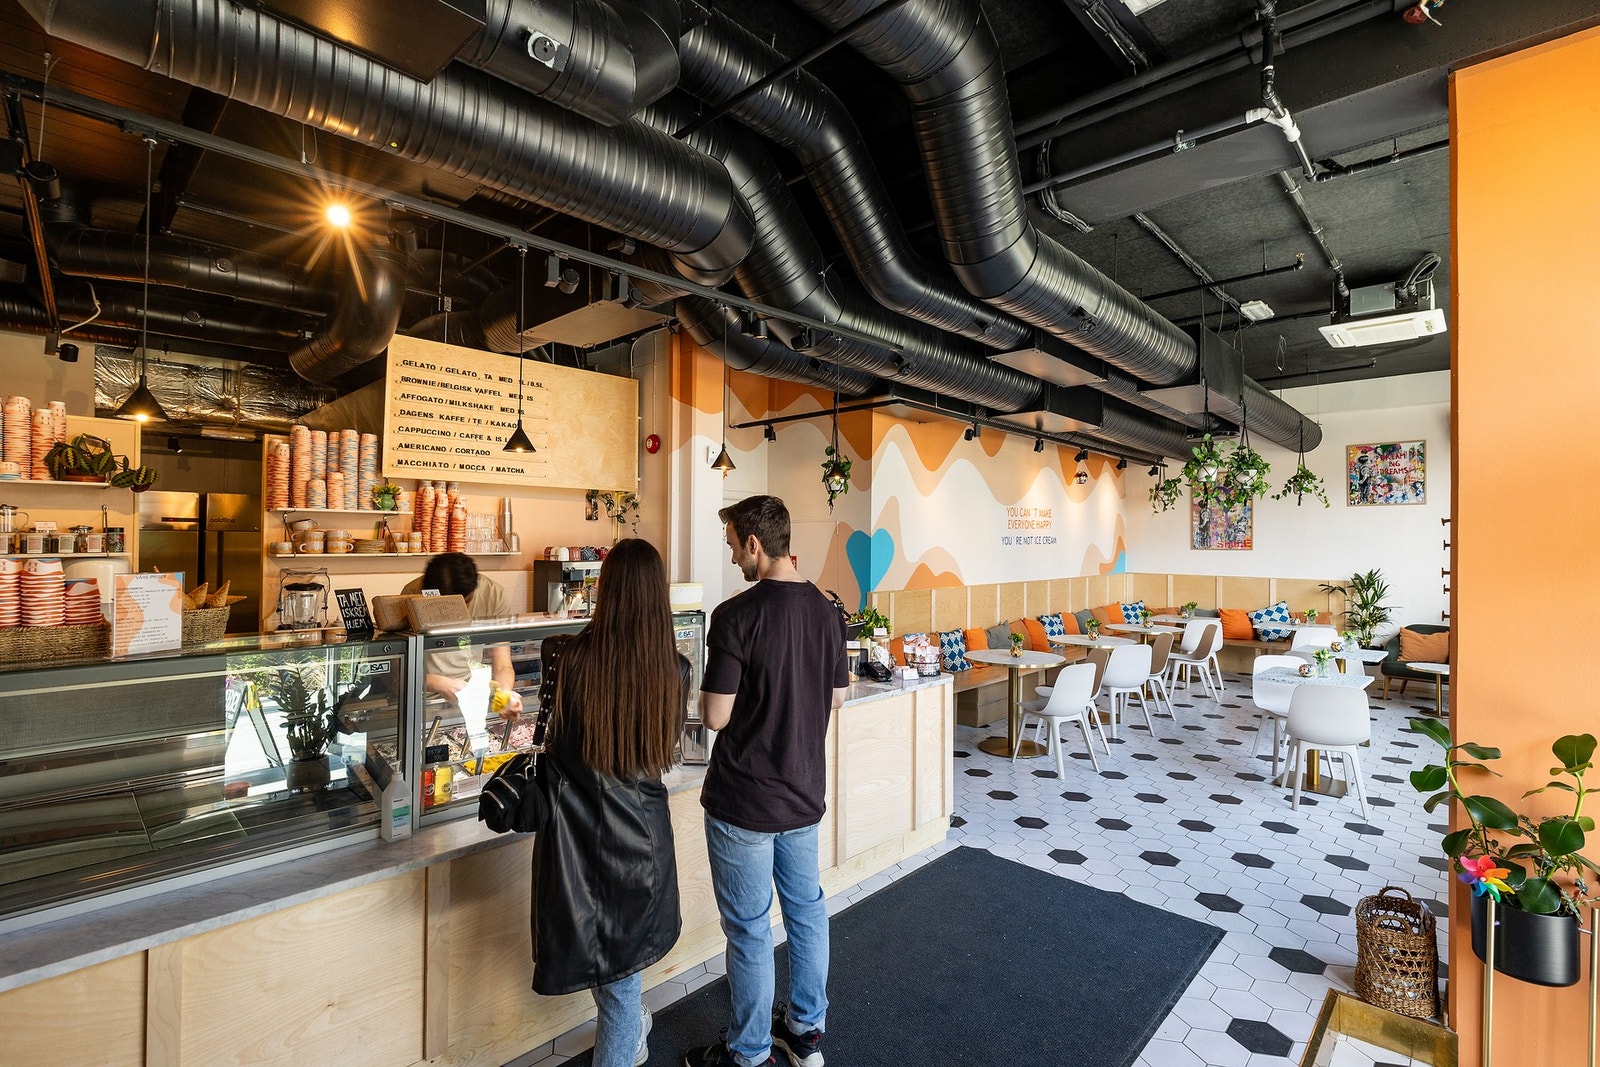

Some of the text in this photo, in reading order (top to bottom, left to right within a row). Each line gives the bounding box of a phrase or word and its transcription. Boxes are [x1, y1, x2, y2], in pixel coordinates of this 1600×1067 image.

[402, 359, 436, 371] GELATO
[499, 376, 513, 384] MED
[474, 387, 502, 397] VAFFEL
[508, 392, 523, 400] MED
[400, 409, 434, 419] DAGENS
[439, 414, 465, 423] KAFFE
[500, 406, 515, 414] MED
[398, 425, 451, 437] CAPPUCCINO
[459, 432, 484, 441] CAFFE
[398, 442, 447, 453] AMERICANO
[455, 447, 491, 456] CORTADO
[1380, 452, 1406, 461] DREAM
[397, 459, 450, 469] MACCHIATO
[459, 463, 486, 471] MOCCA
[496, 466, 525, 474] MATCHA
[1380, 466, 1409, 475] DREAMS
[1006, 507, 1019, 517] YOU
[1039, 508, 1052, 518] MAKE
[1007, 519, 1052, 530] EVERYONE HAPPY
[1023, 536, 1033, 545] NOT
[1034, 536, 1042, 545] ICE
[1042, 536, 1057, 545] CREAM
[336, 594, 350, 608] TA
[345, 618, 368, 630] HJEM
